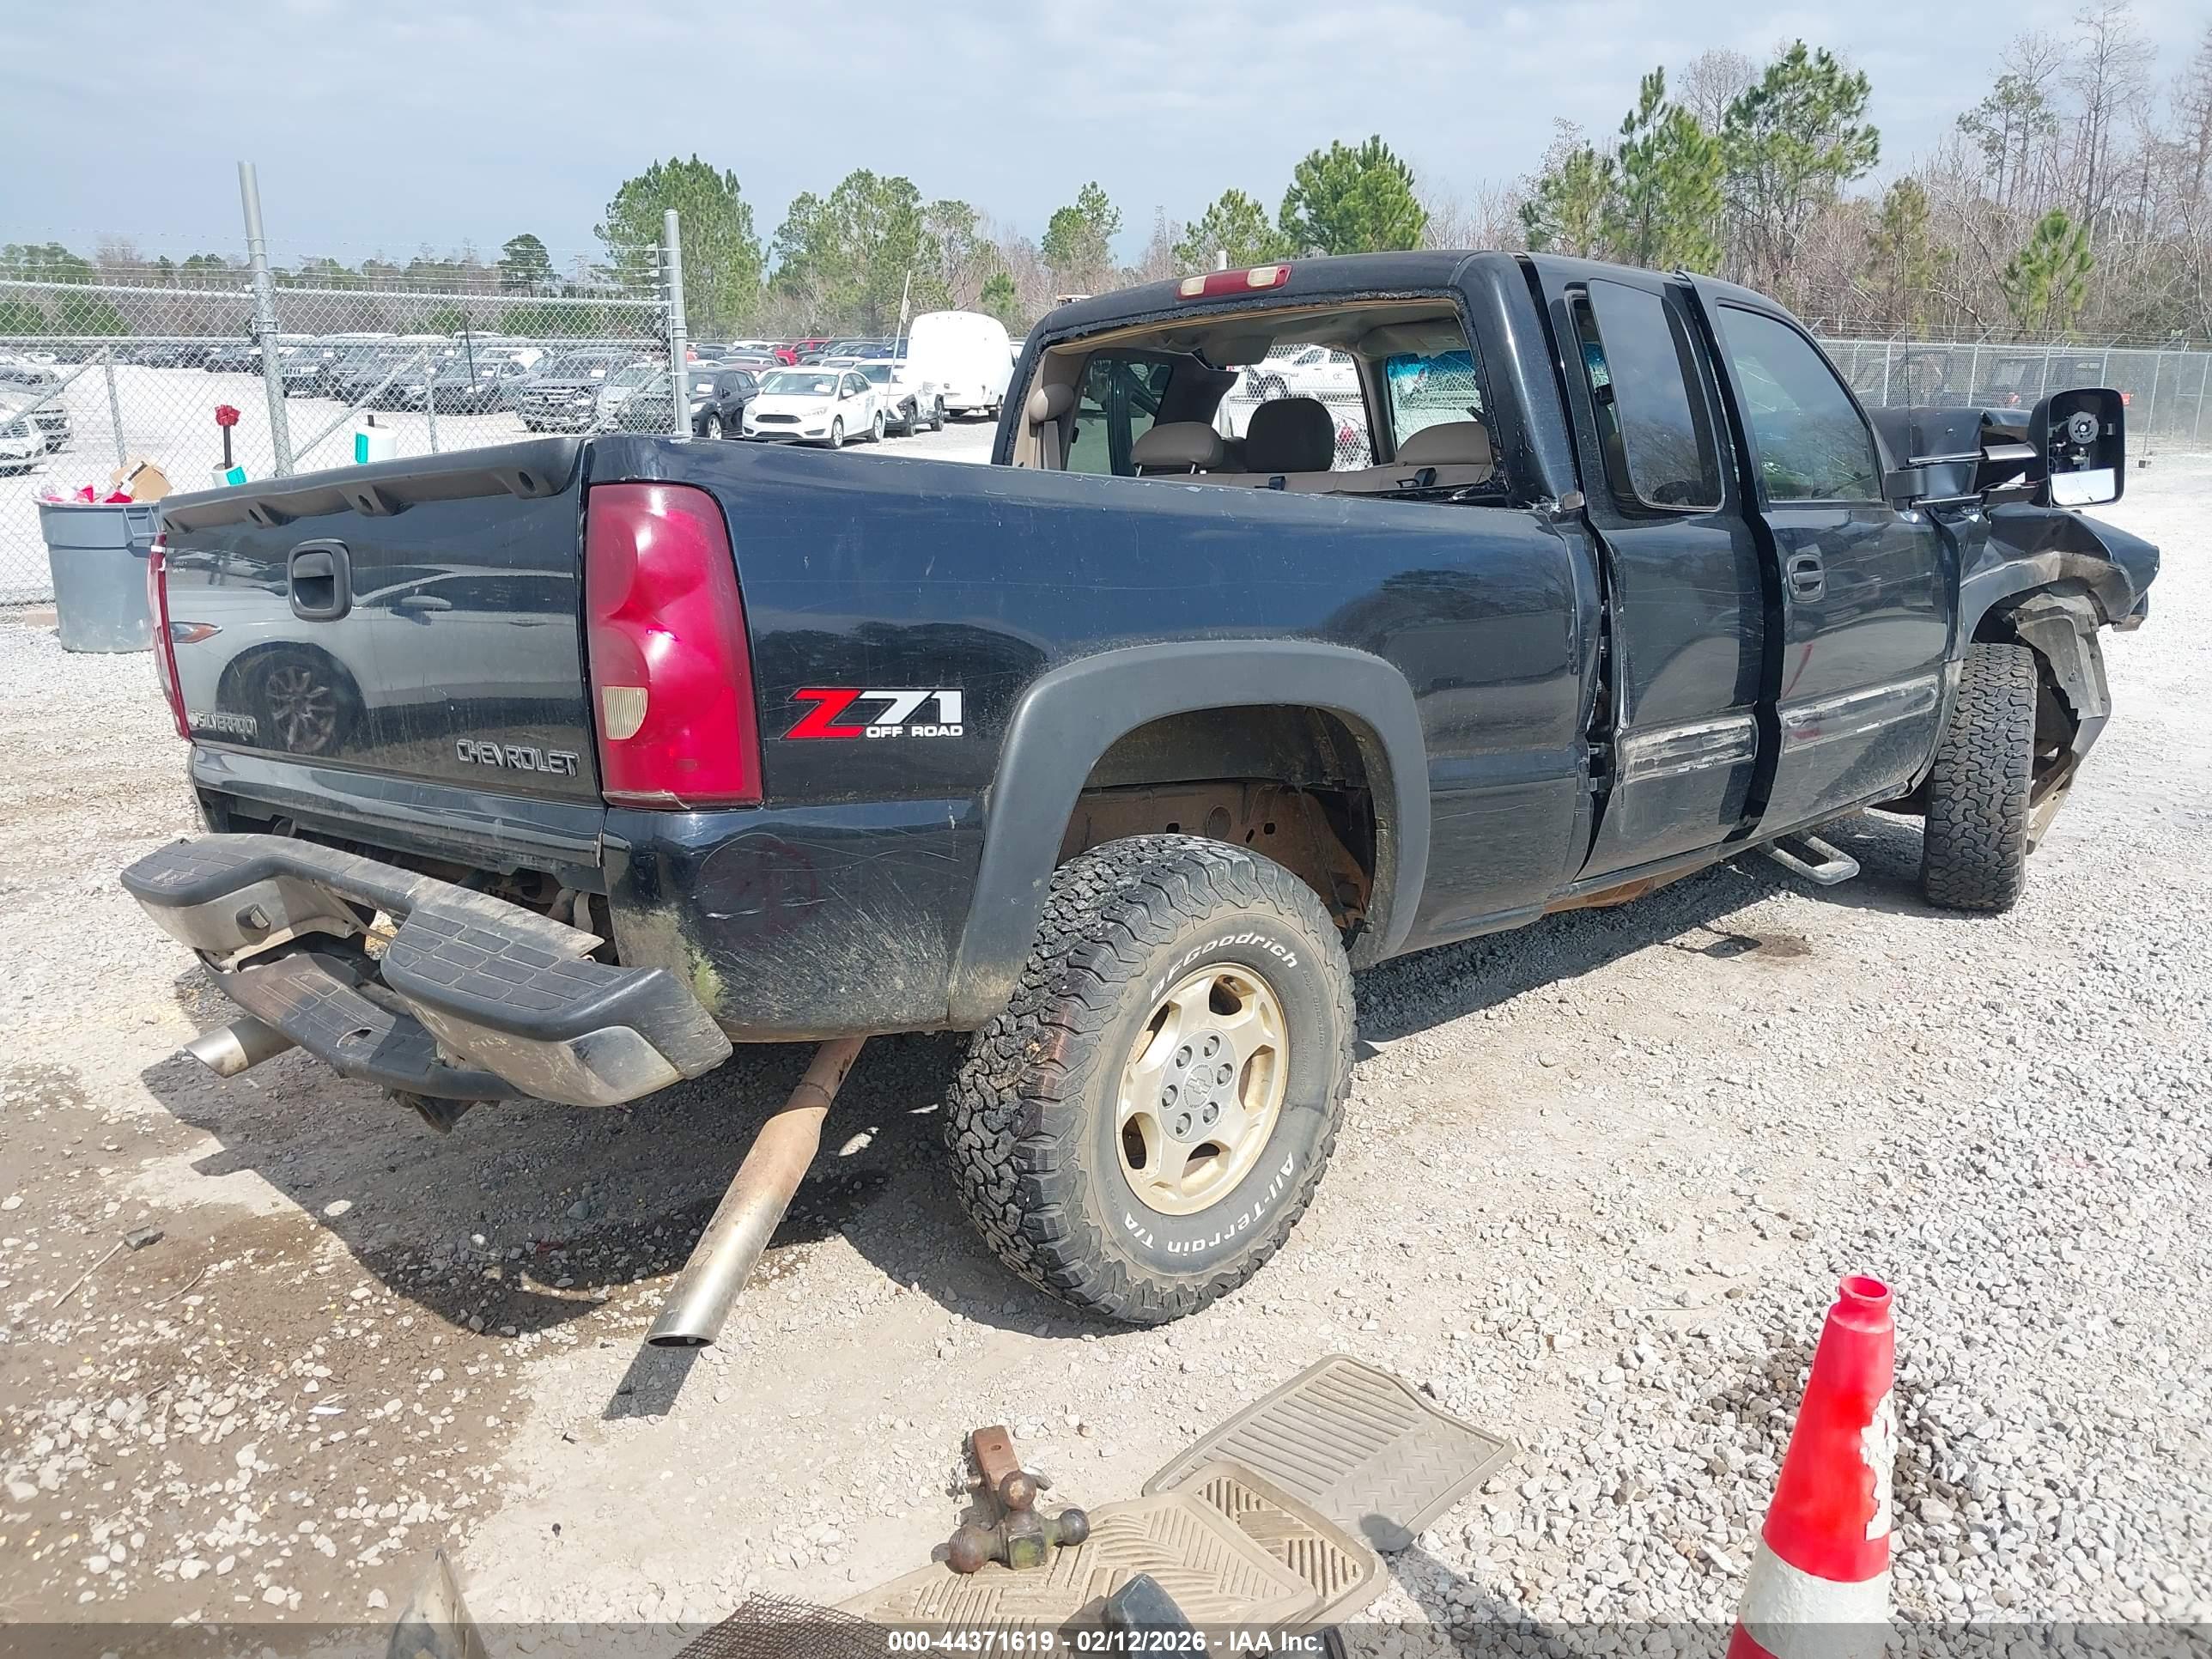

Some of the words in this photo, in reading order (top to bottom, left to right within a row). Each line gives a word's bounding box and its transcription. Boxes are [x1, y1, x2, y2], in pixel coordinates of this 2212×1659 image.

[782, 690, 962, 738] Z71
[866, 726, 902, 738] OFF
[911, 726, 963, 737] ROAD
[456, 739, 580, 776] CHEVROLET
[1150, 932, 1298, 1004] BFGoodrich
[1167, 1152, 1295, 1257] All-Terrain
